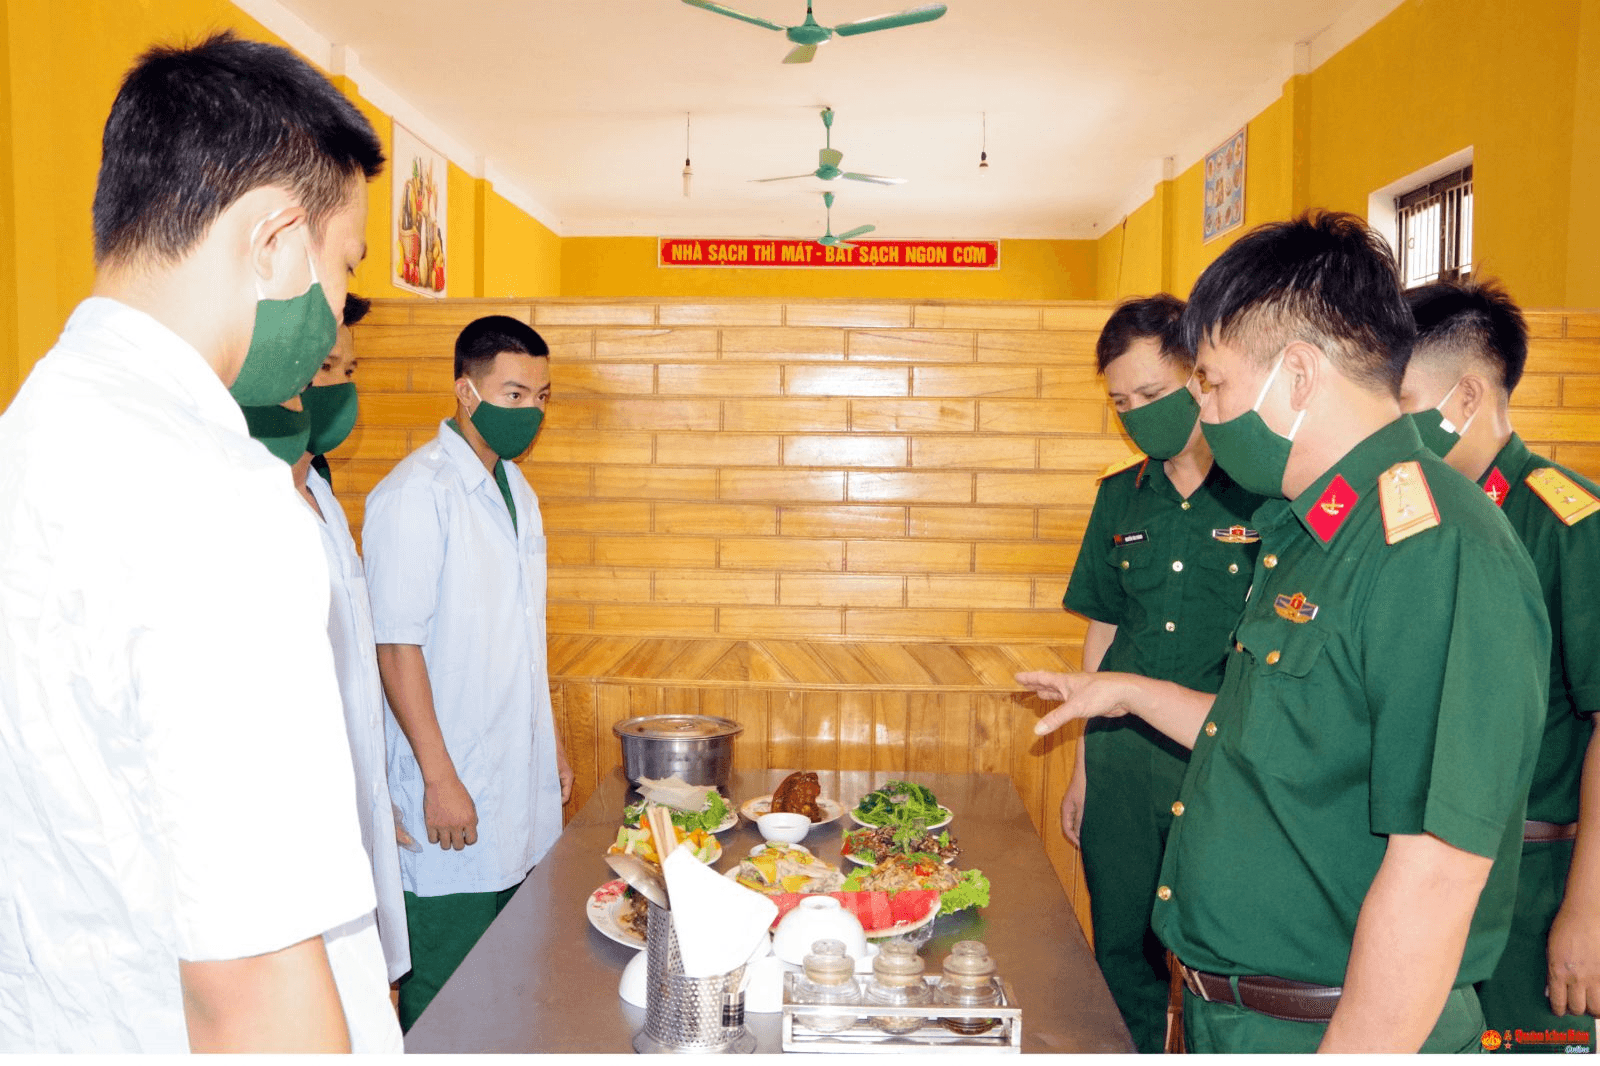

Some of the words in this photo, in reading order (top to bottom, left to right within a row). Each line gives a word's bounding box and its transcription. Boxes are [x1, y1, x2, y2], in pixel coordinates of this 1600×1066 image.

[671, 241, 703, 261] NHÀ
[708, 244, 748, 265] SẠCH
[753, 242, 776, 262] THÌ
[781, 242, 814, 262] MÁT
[859, 245, 899, 266] SẠCH
[905, 246, 947, 264] NGON
[953, 245, 987, 264] CƠM
